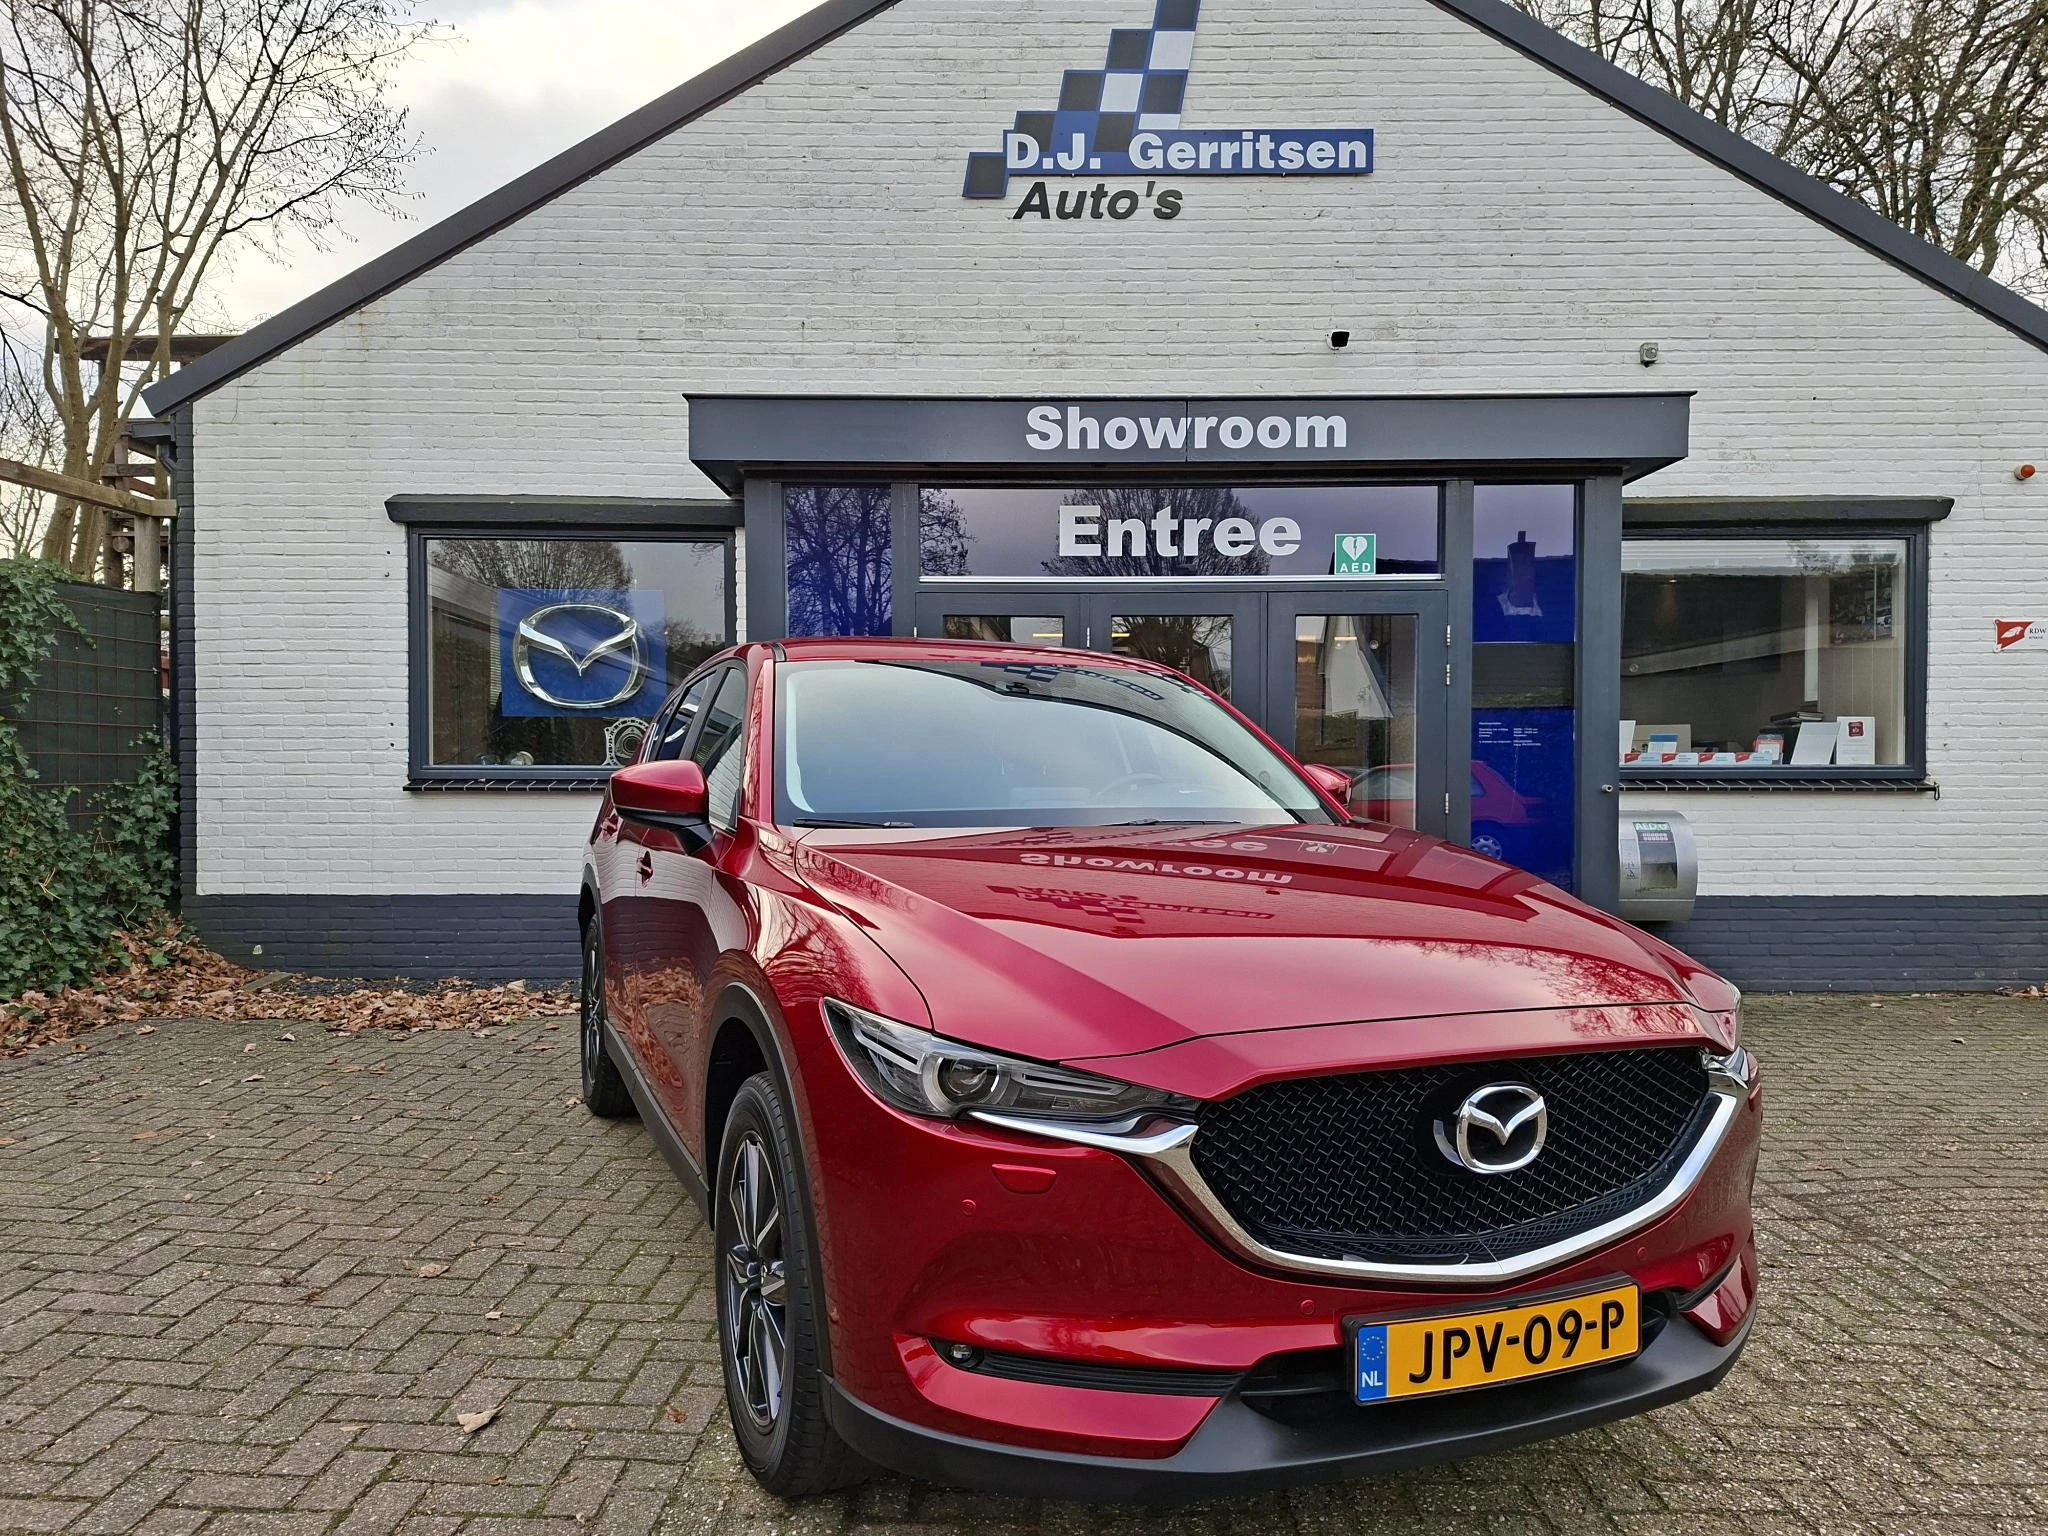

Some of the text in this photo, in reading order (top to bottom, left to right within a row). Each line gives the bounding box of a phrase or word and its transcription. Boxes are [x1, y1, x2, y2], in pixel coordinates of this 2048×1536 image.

[1006, 131, 1367, 170] D.J. Gerritsen
[1012, 181, 1184, 220] Auto's
[1025, 405, 1347, 450] Showroom
[1058, 505, 1302, 557] Entree
[1339, 563, 1372, 573] AED
[1408, 1299, 1625, 1384] JPV-09-P
[1361, 1370, 1384, 1388] NL
